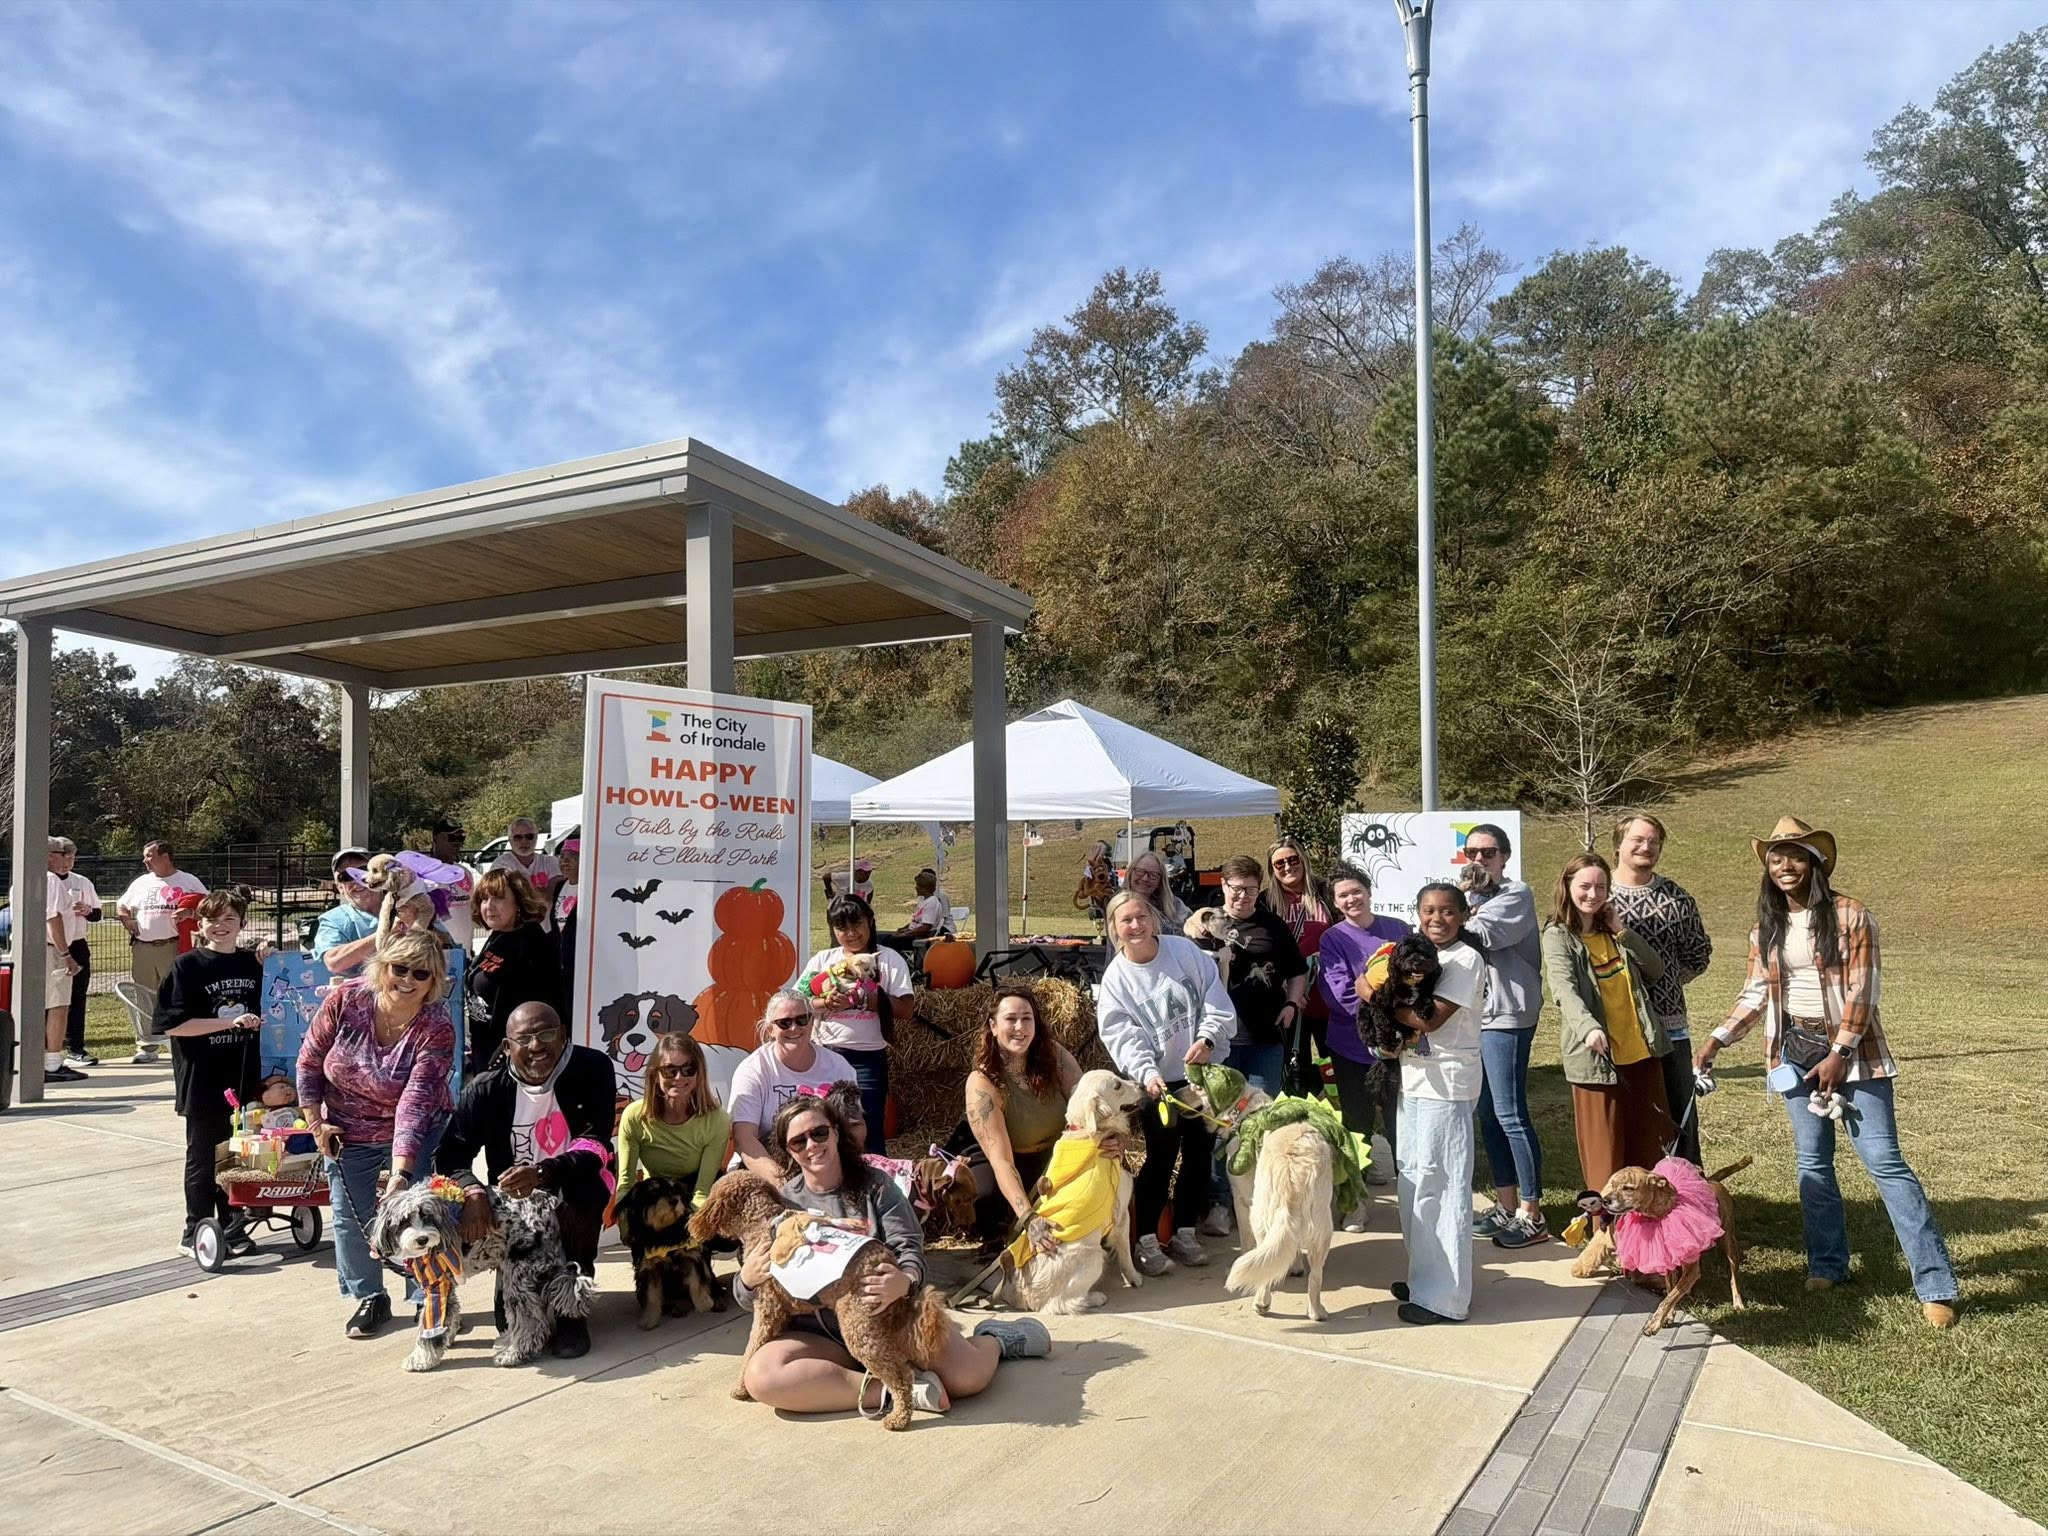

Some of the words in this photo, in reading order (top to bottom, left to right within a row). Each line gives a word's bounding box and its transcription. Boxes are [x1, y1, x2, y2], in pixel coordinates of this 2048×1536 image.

[680, 713, 712, 729] The
[715, 717, 747, 735] City
[680, 732, 698, 745] of
[701, 733, 766, 751] Irondale
[650, 757, 756, 785] HAPPY
[606, 786, 795, 814] HOWL-O-WEEN
[615, 816, 675, 836] Tails
[678, 819, 698, 845] by
[705, 821, 731, 837] the
[735, 822, 786, 841] Rails
[626, 848, 649, 863] at
[653, 845, 723, 865] Ellard
[727, 848, 778, 866] Park
[1424, 876, 1440, 884] The
[1373, 902, 1385, 912] BY
[1388, 903, 1405, 912] THE
[204, 981, 220, 995] I'M
